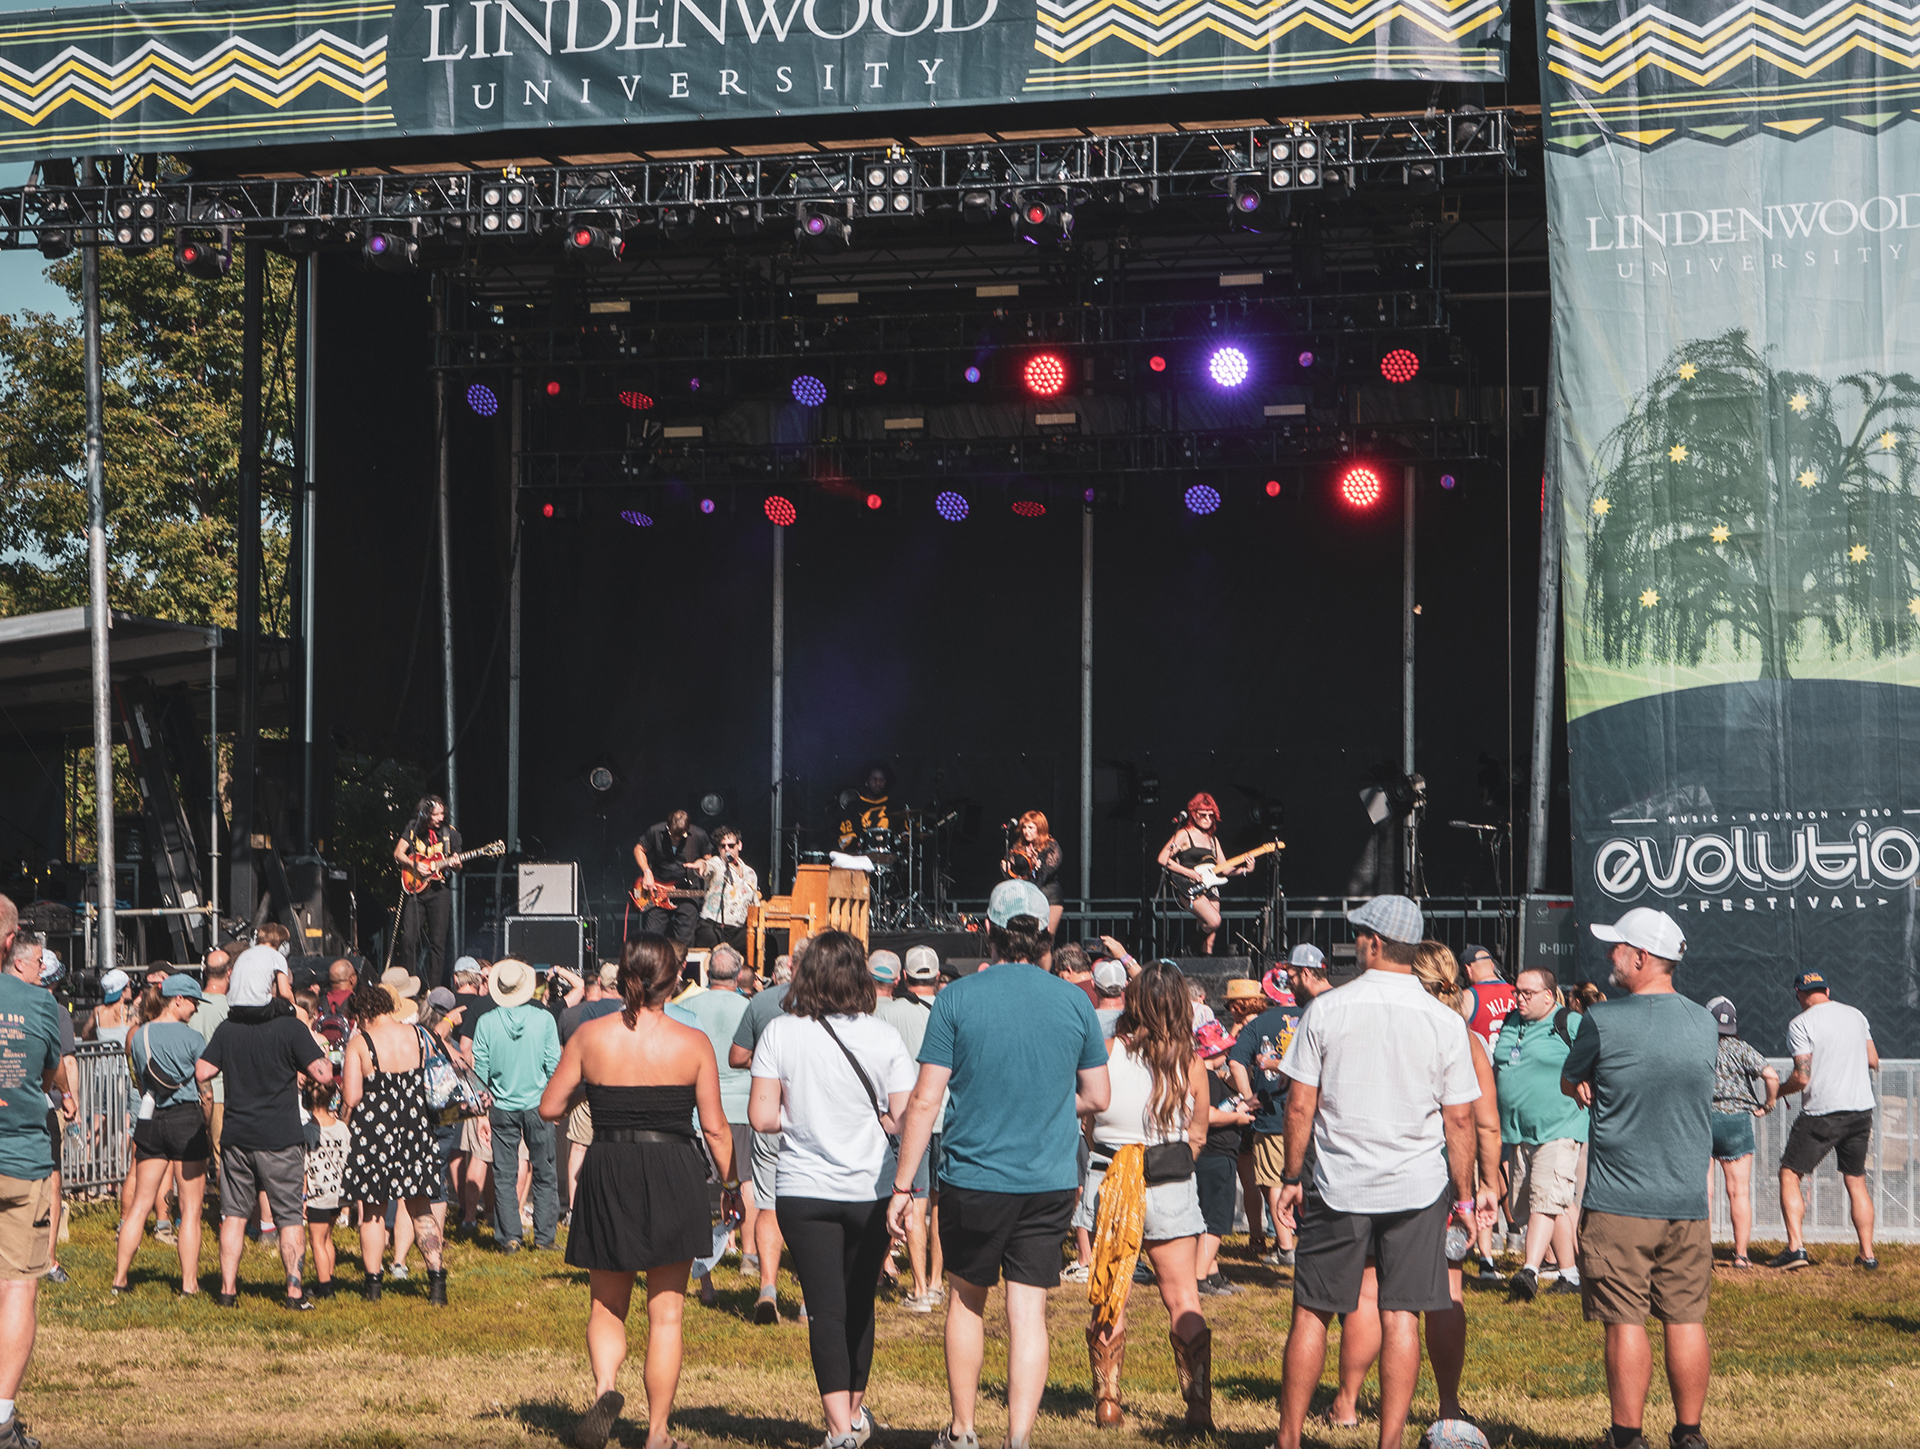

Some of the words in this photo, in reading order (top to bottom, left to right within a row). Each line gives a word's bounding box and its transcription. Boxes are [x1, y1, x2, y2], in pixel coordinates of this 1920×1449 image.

[422, 0, 999, 63] LINDENWOOD
[472, 58, 944, 110] UNIVERSITY
[1585, 192, 1920, 252] LINDENWOOD
[1617, 244, 1903, 279] UNIVERSITY
[1668, 814, 1719, 824] MUSIC
[1750, 810, 1829, 821] BOURBON
[1860, 808, 1892, 818] BBQ
[1595, 822, 1920, 900] evolutio
[1700, 896, 1866, 912] FESTIVAL
